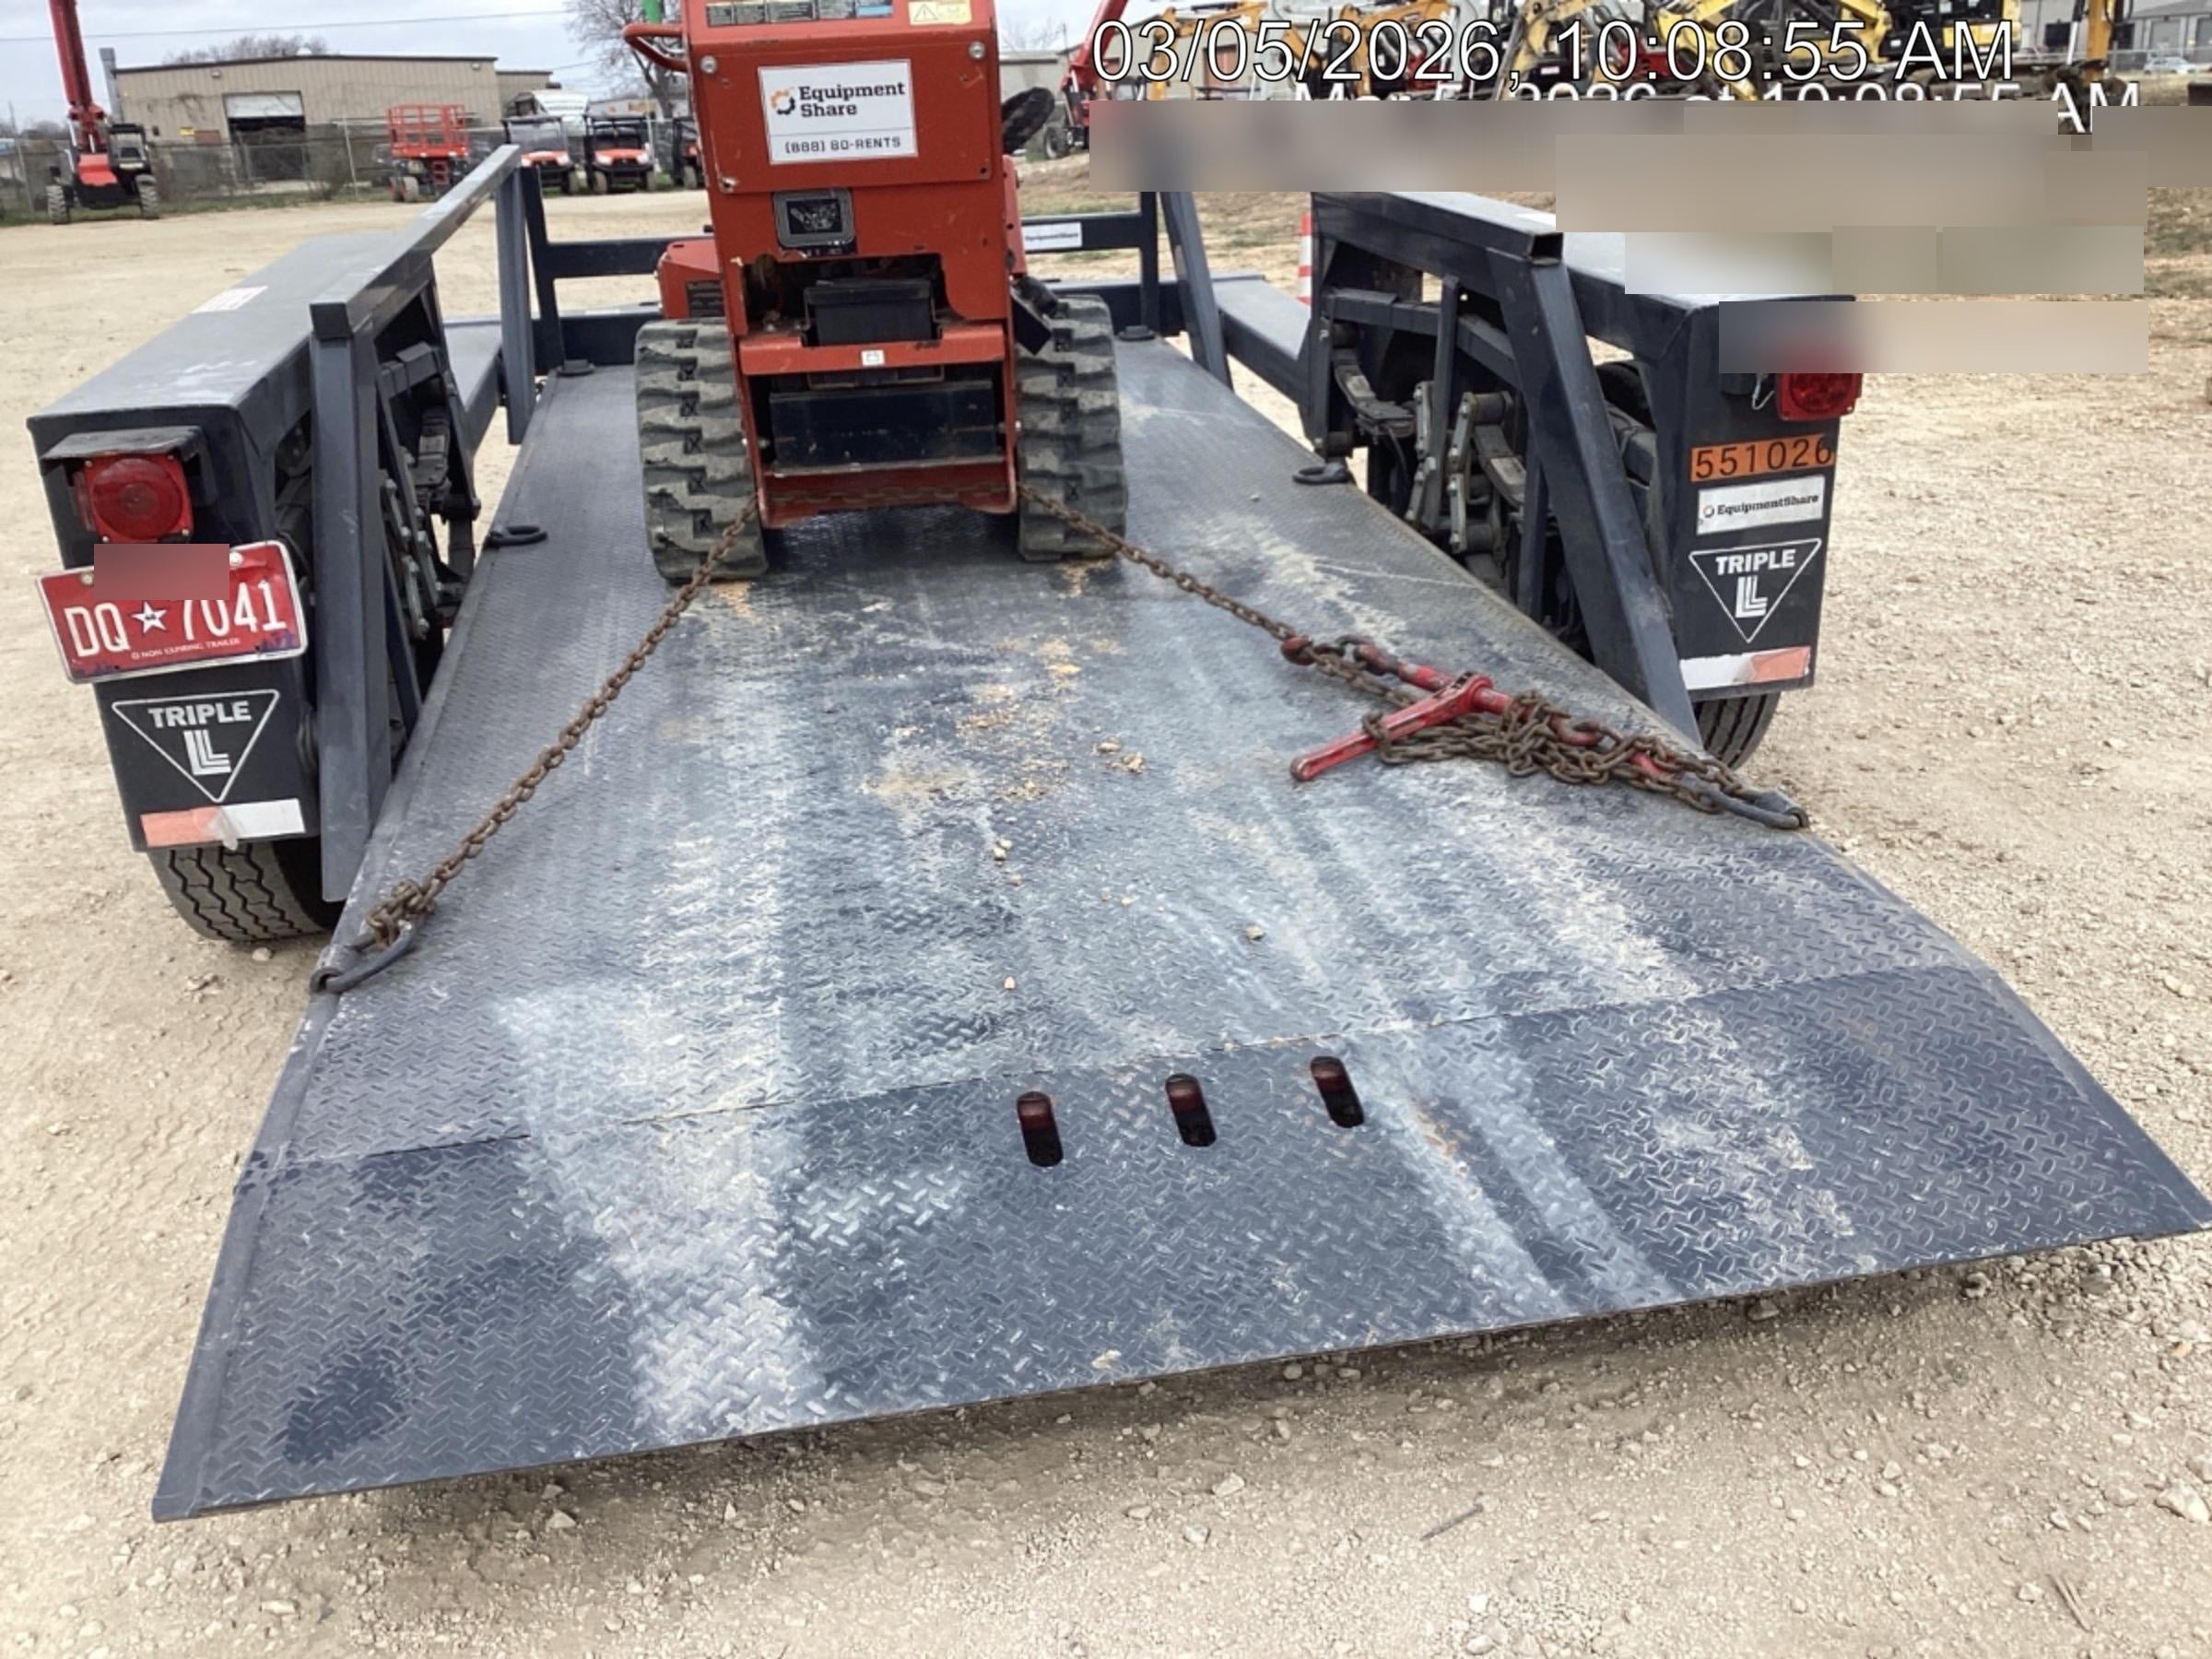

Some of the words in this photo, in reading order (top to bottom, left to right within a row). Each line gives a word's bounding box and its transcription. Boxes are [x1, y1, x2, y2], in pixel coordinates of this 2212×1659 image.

[799, 82, 905, 101] Equipment
[800, 102, 857, 118] Share
[1695, 437, 1831, 478] 551026
[1717, 495, 1819, 516] EquipmentShare
[1715, 549, 1796, 575] TRIPLE
[65, 603, 130, 657] DQ
[147, 700, 251, 727] TRIPLE
